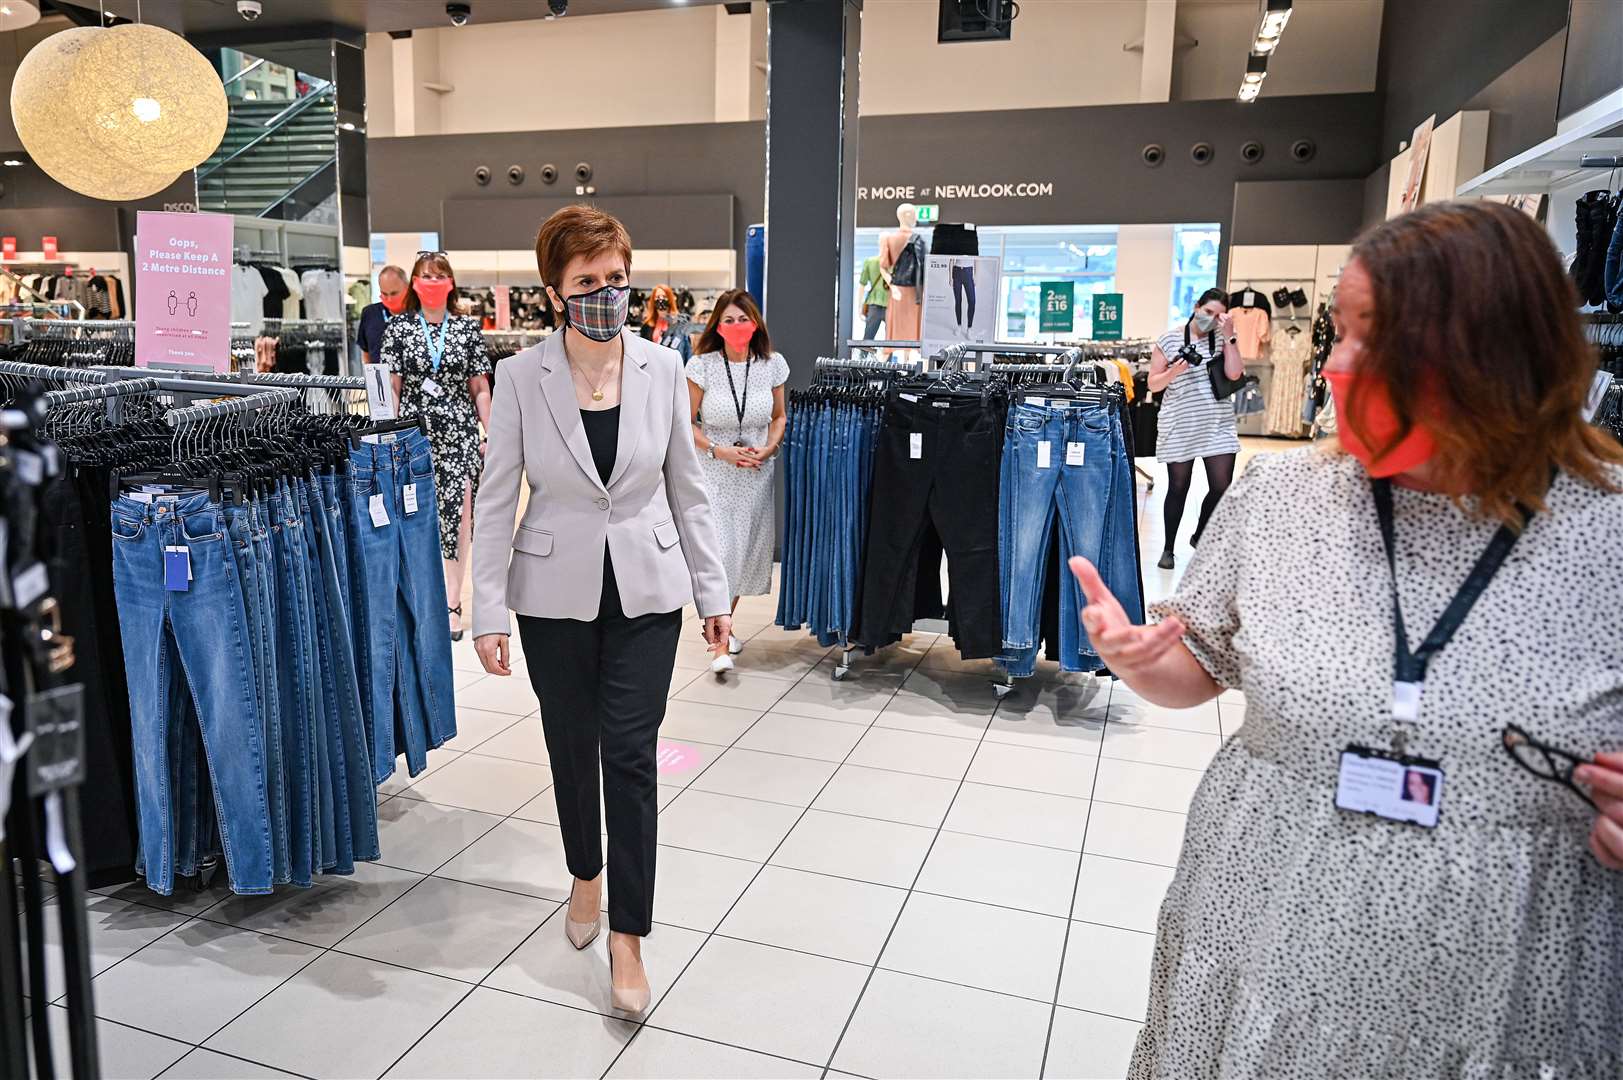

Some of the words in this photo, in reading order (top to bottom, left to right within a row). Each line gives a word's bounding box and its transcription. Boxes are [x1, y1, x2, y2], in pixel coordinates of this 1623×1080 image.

[871, 186, 915, 199] MORE
[920, 188, 931, 196] AT
[935, 183, 1053, 198] NEWLOOK.COM
[169, 238, 198, 249] Oops,
[149, 249, 182, 260] Please
[183, 251, 209, 263] Keep
[211, 253, 219, 262] A
[142, 262, 149, 272] 2
[150, 263, 180, 273] Metre
[182, 264, 226, 276] Distance
[1047, 290, 1055, 300] 2
[1047, 300, 1067, 312] £16
[1098, 301, 1106, 311] 2
[1098, 311, 1117, 321] £16
